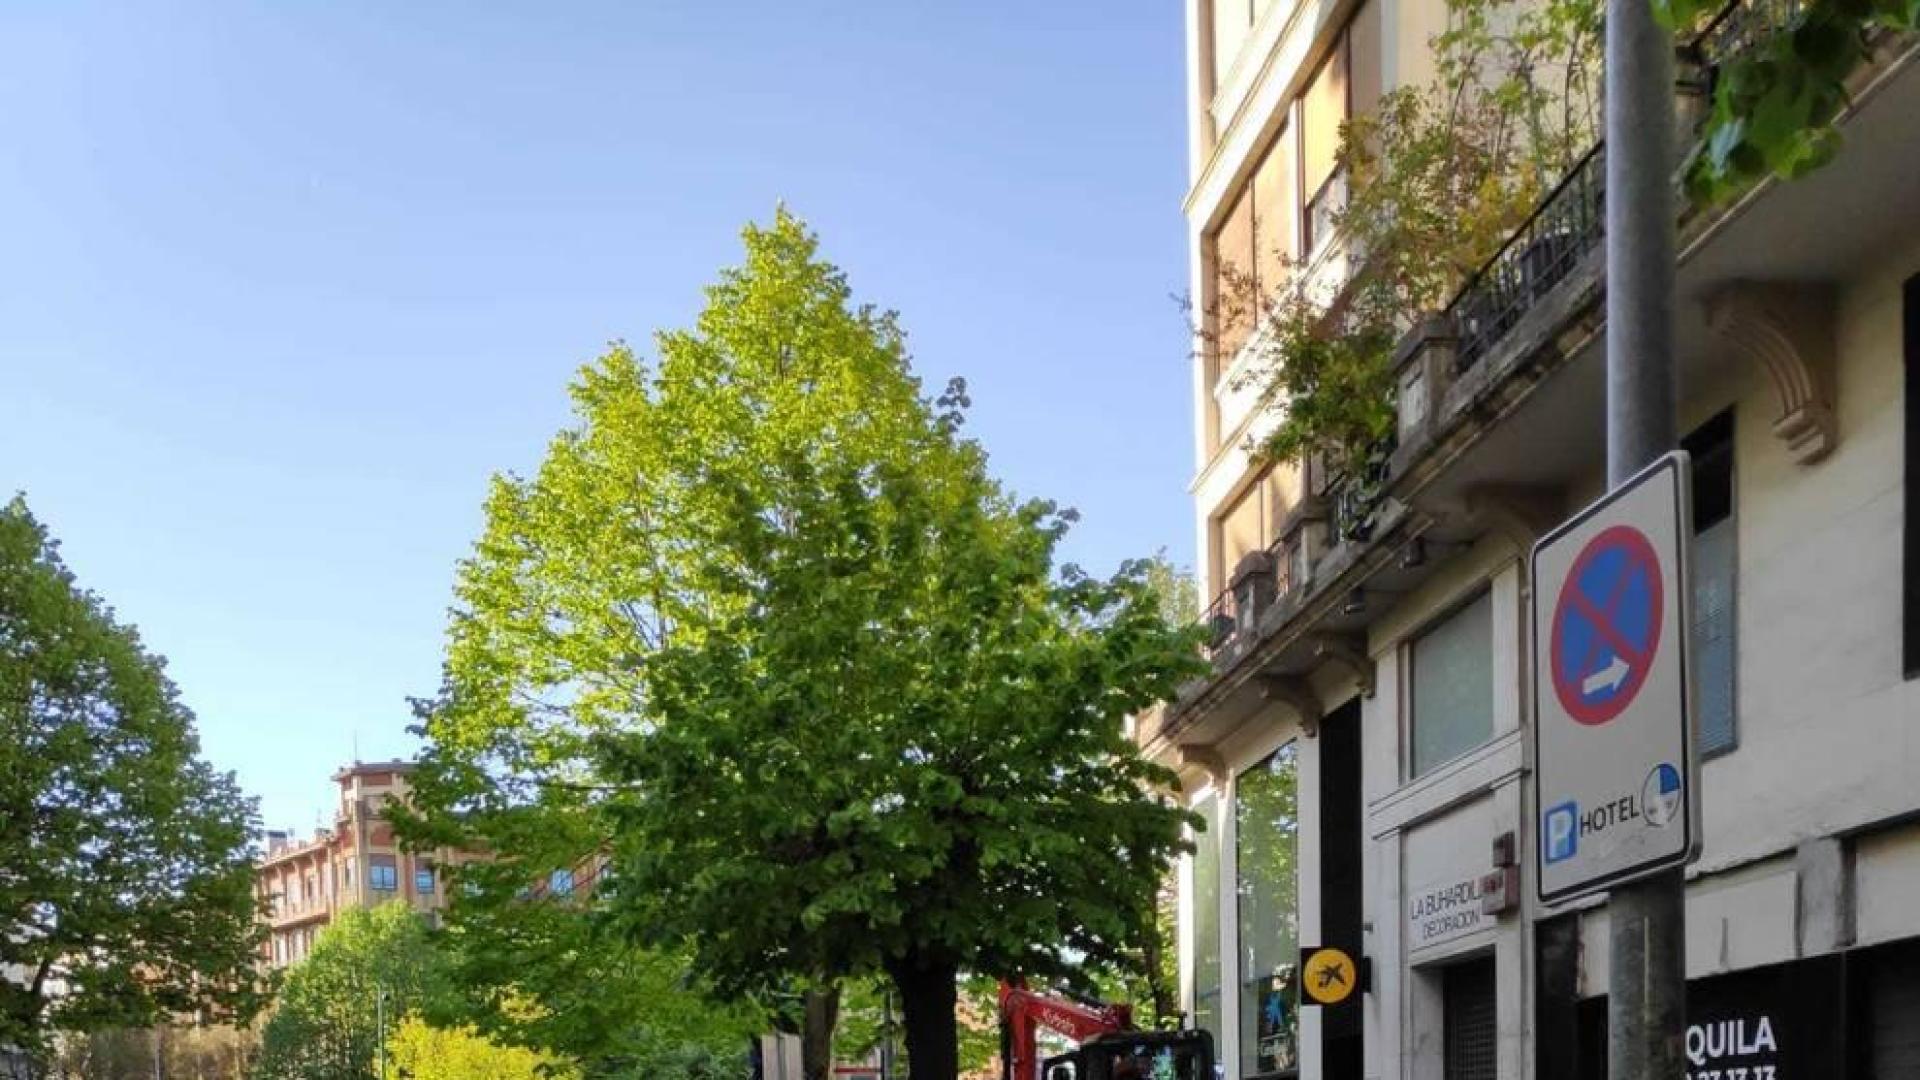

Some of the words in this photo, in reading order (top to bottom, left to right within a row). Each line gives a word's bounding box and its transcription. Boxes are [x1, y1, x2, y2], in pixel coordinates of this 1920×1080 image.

[1579, 795, 1640, 838] HOTEL
[1411, 899, 1425, 920] LA
[1685, 1015, 1777, 1066] QUILA
